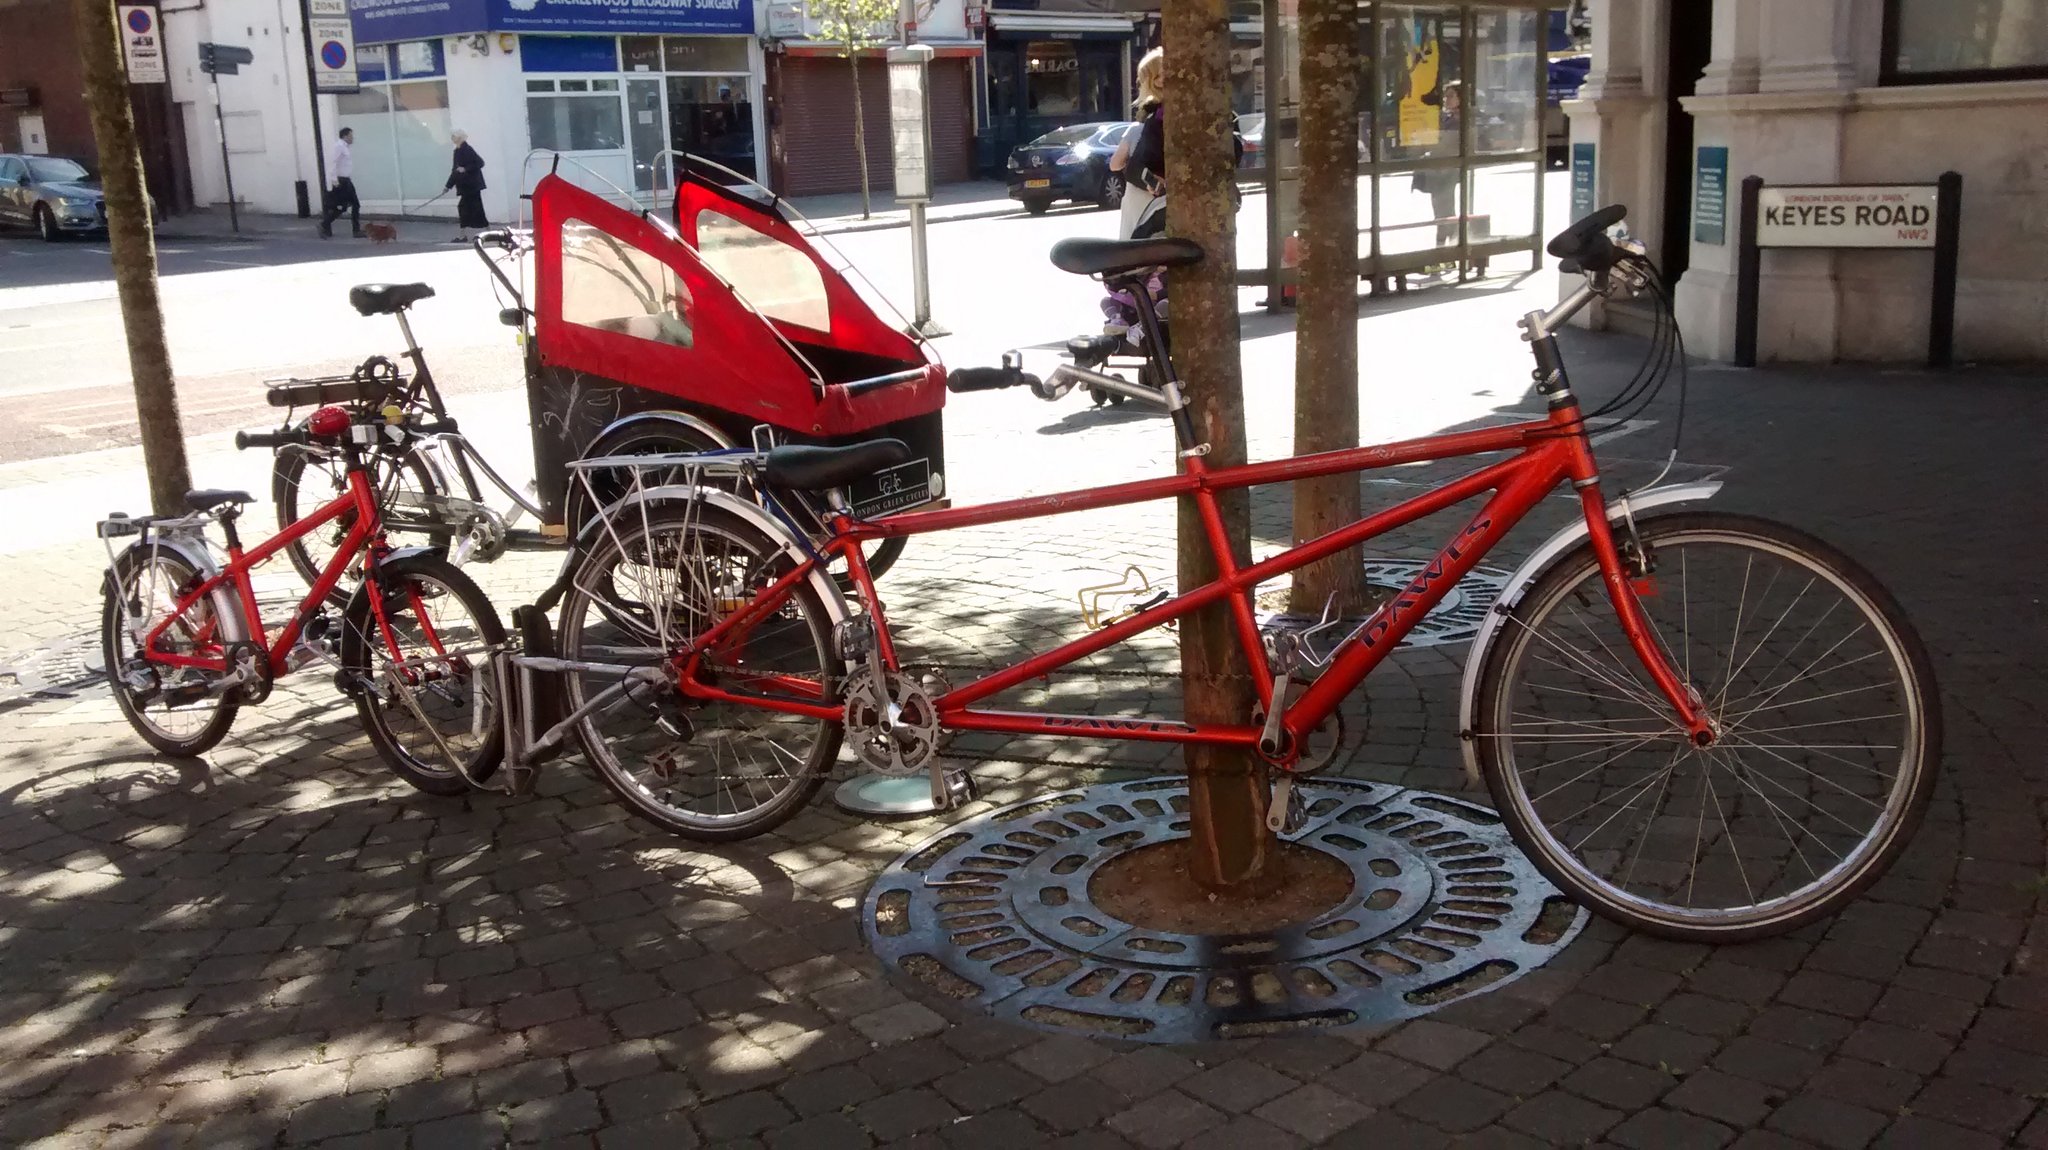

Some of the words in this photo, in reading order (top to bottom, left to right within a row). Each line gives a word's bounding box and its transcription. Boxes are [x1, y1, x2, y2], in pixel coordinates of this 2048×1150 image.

[314, 2, 342, 10] ZONE
[695, 0, 739, 10] SURGERY
[1765, 205, 1846, 226] KEYES
[1855, 205, 1930, 226] ROAD
[1897, 229, 1929, 240] NW2
[856, 504, 881, 518] ONDON
